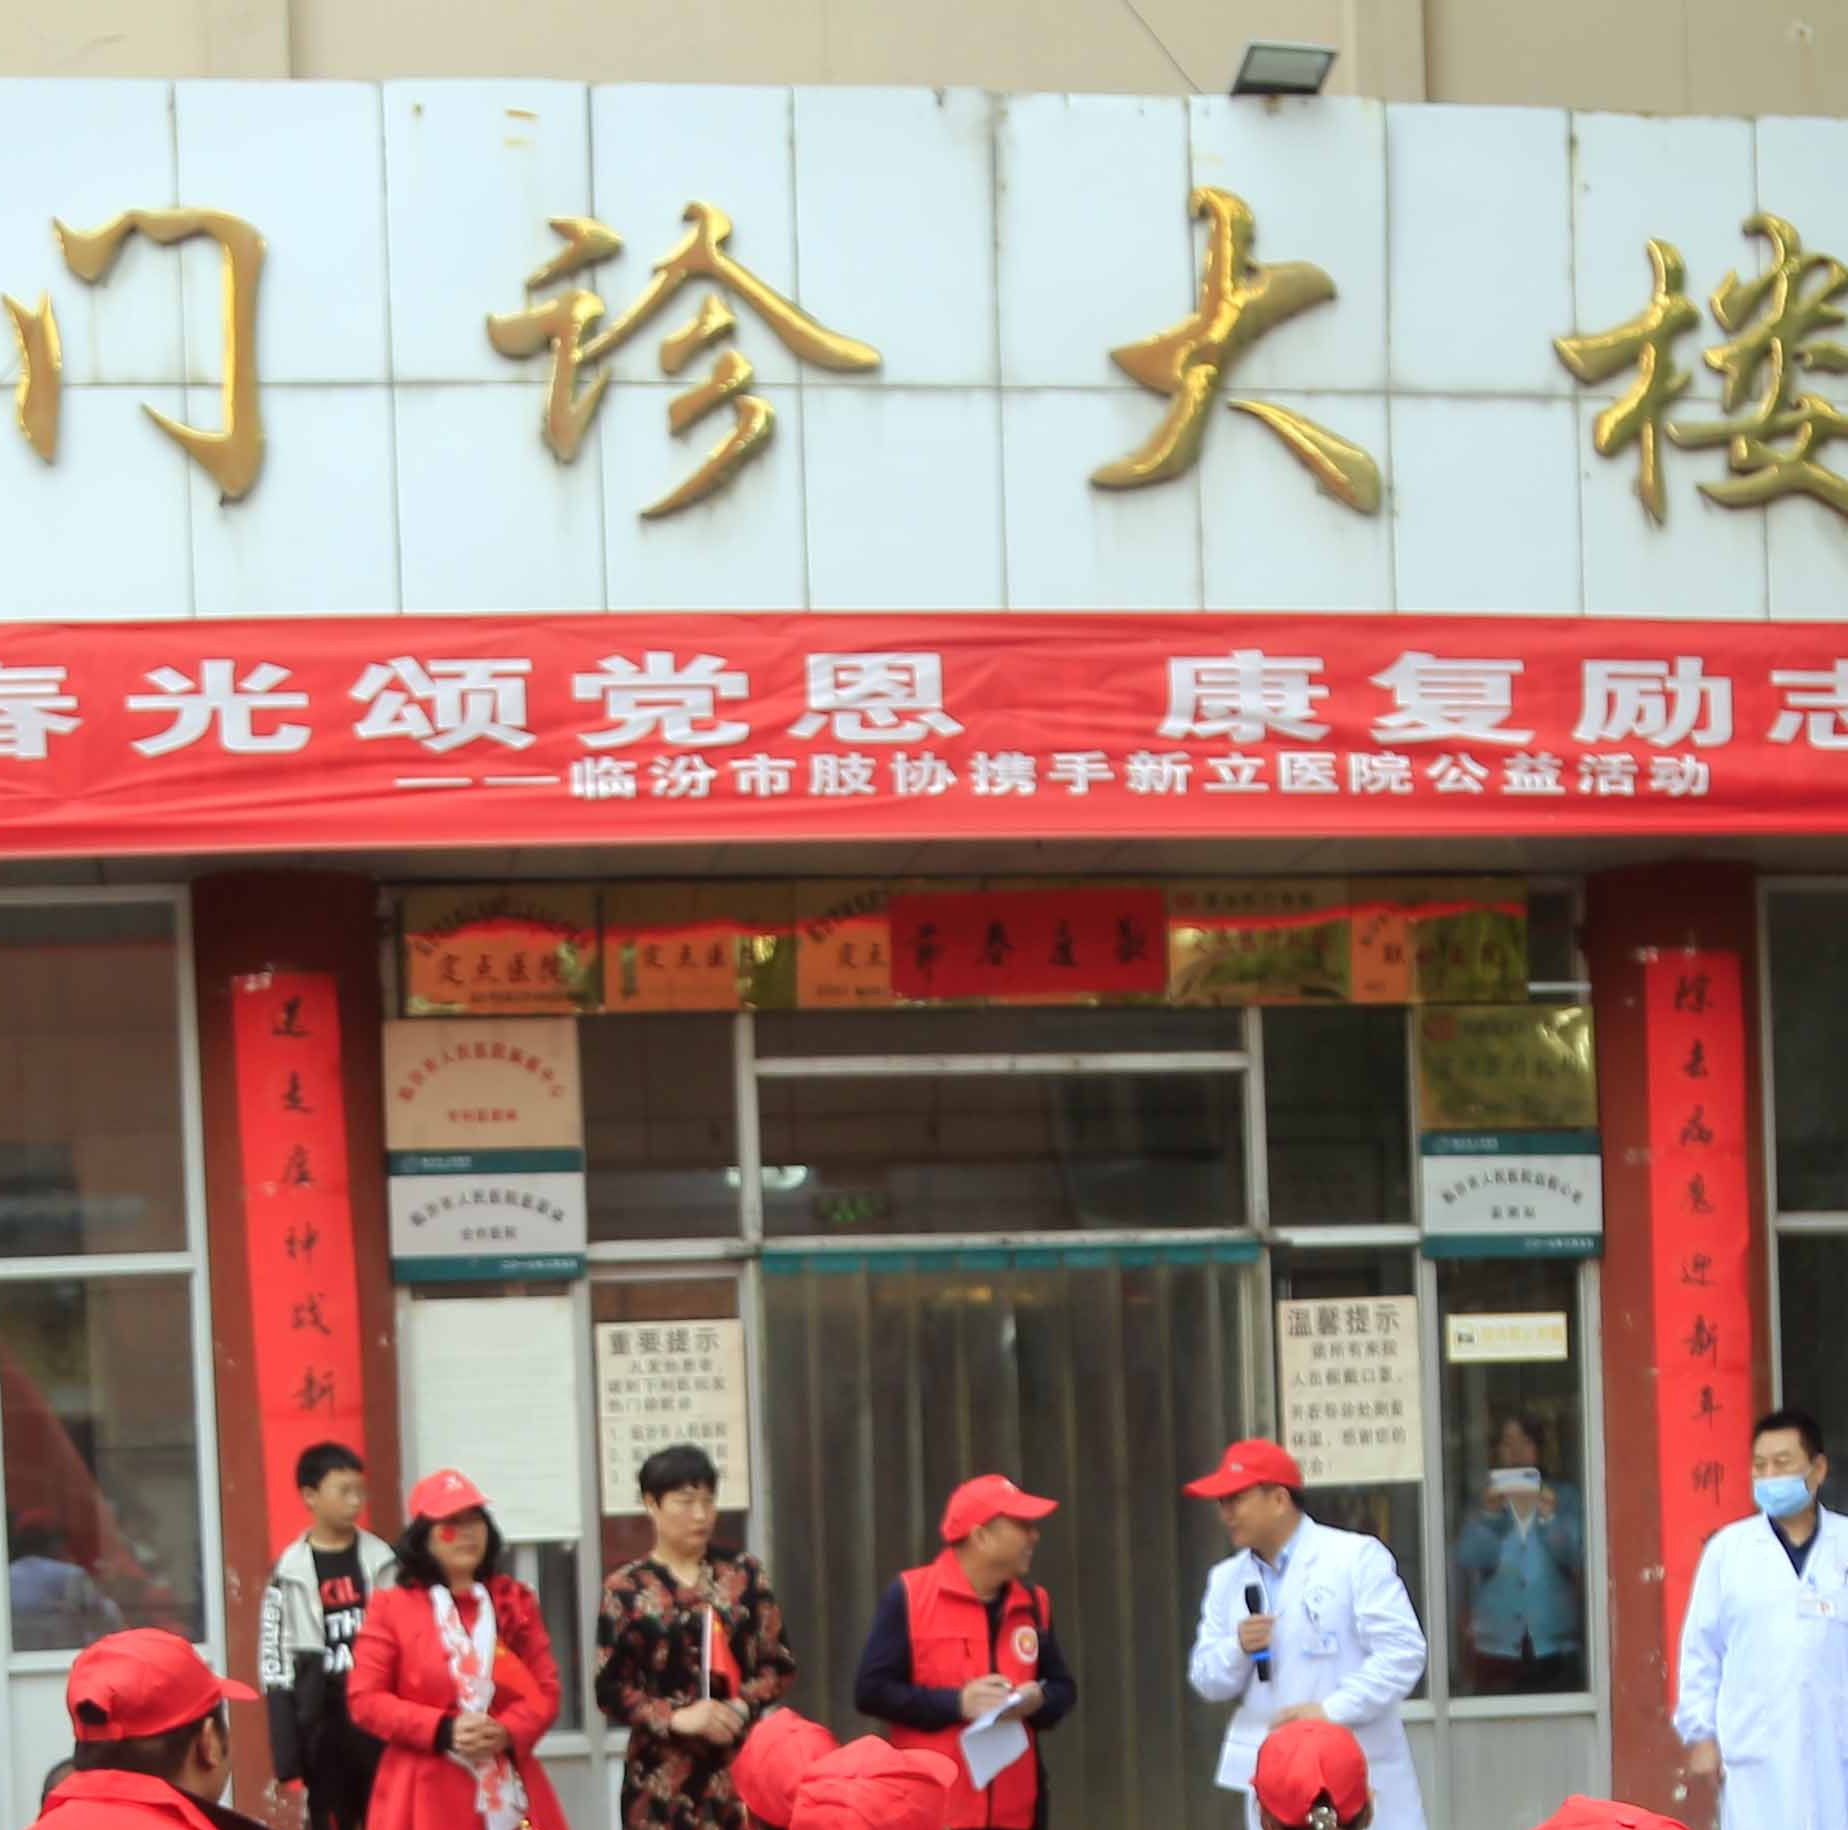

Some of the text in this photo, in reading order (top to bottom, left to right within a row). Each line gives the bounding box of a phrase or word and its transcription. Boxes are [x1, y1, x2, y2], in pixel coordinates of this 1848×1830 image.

[1287, 1305, 1401, 1337] 温馨提示
[608, 1327, 720, 1355] 重要提示
